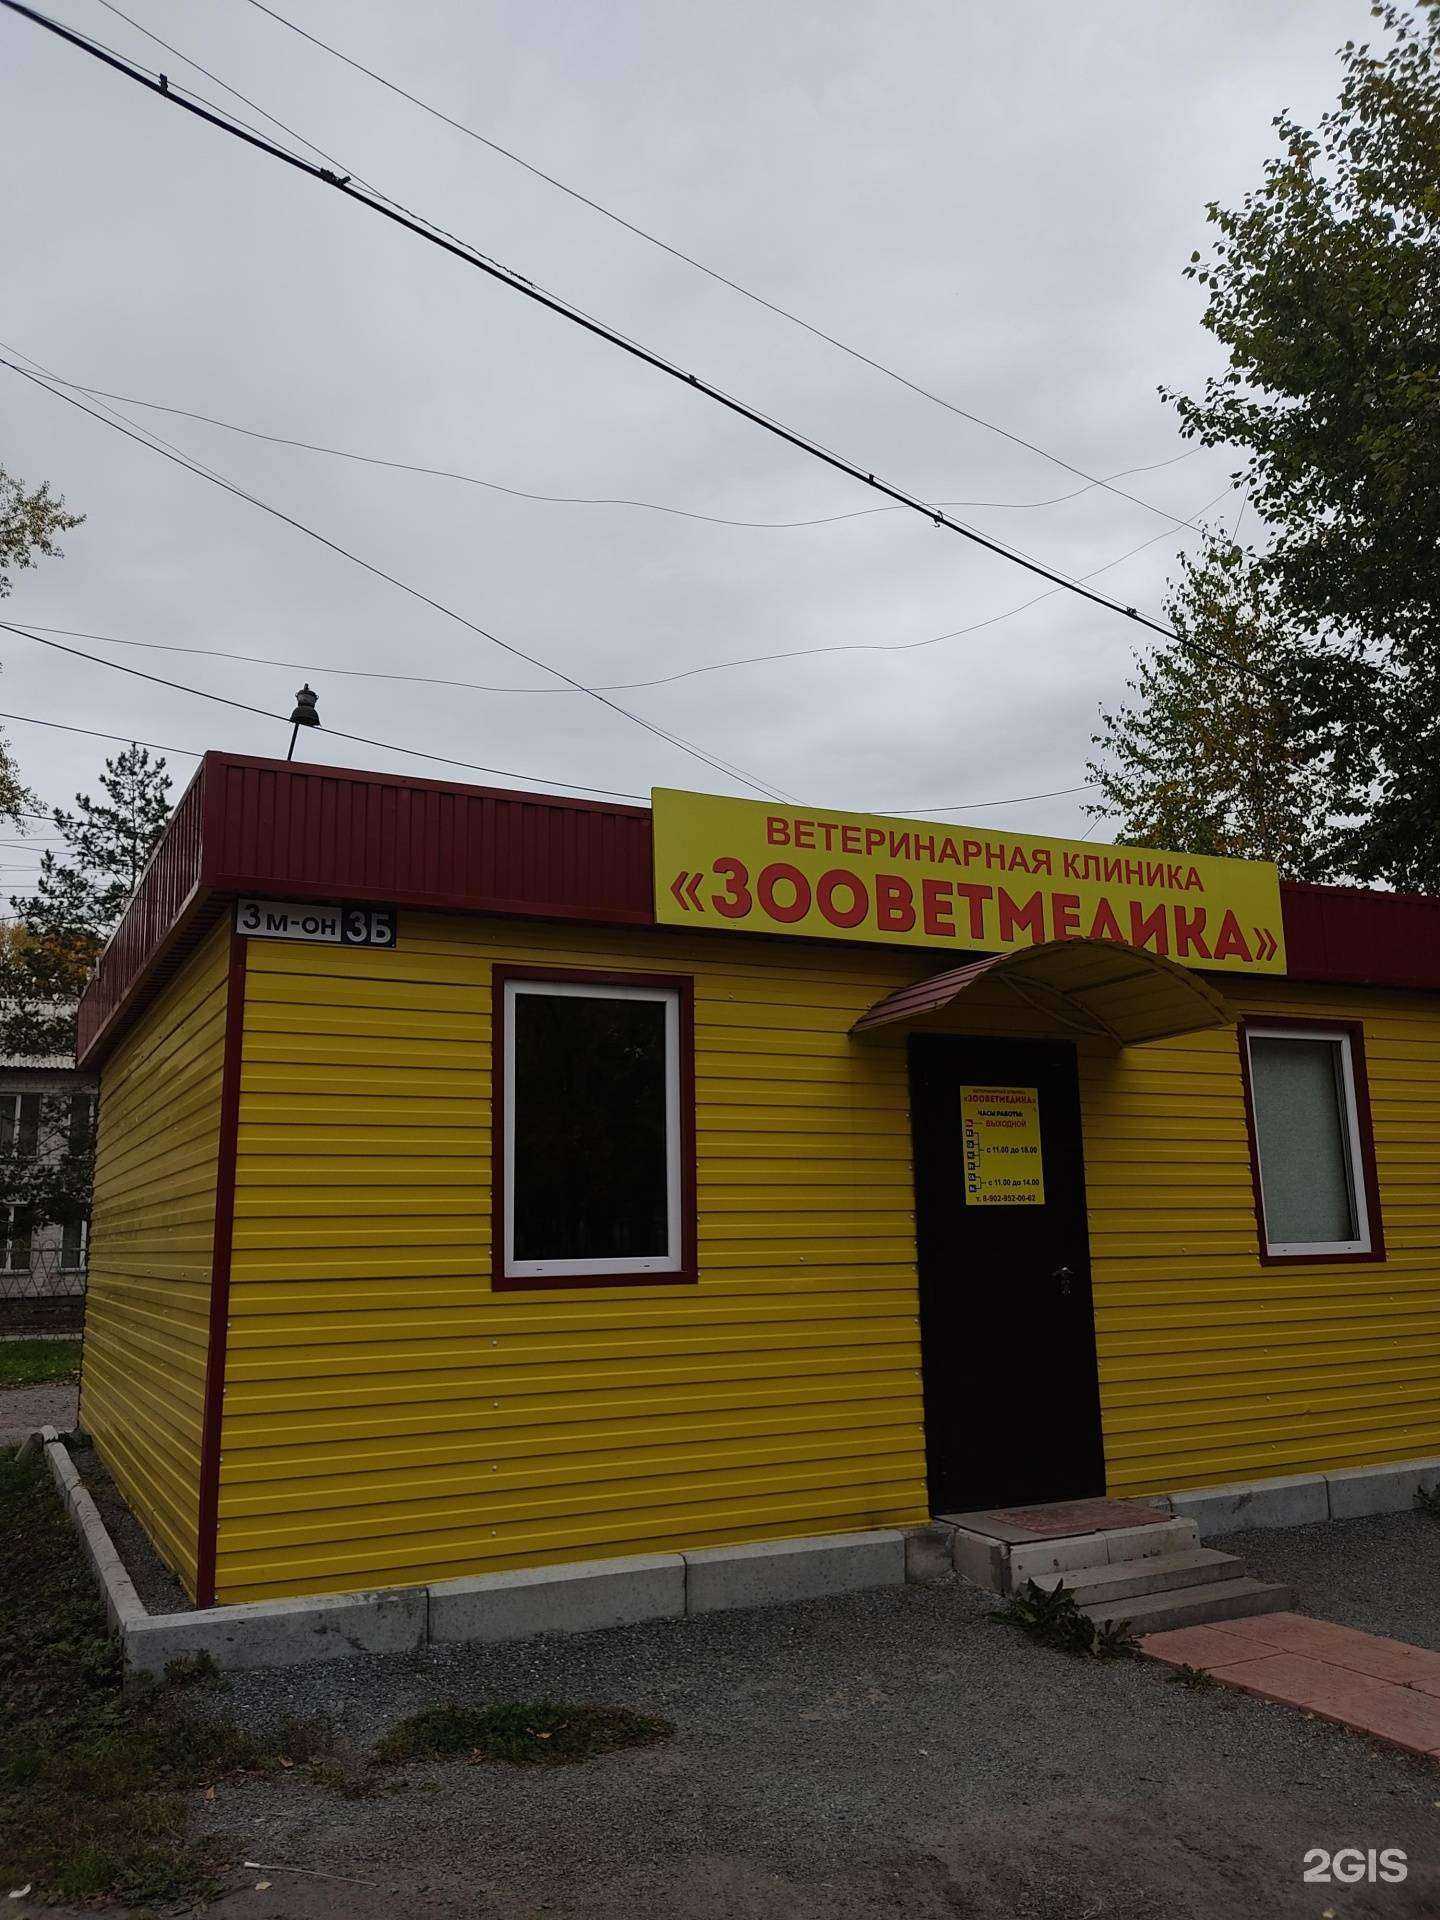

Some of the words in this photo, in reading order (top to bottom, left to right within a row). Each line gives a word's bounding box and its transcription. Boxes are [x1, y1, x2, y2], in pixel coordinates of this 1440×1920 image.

[766, 816, 1053, 876] ВЕТЕРИНАРНАЯ
[1062, 852, 1205, 893] КЛИНИКА
[242, 903, 261, 930] 3
[346, 911, 393, 944] 3Б
